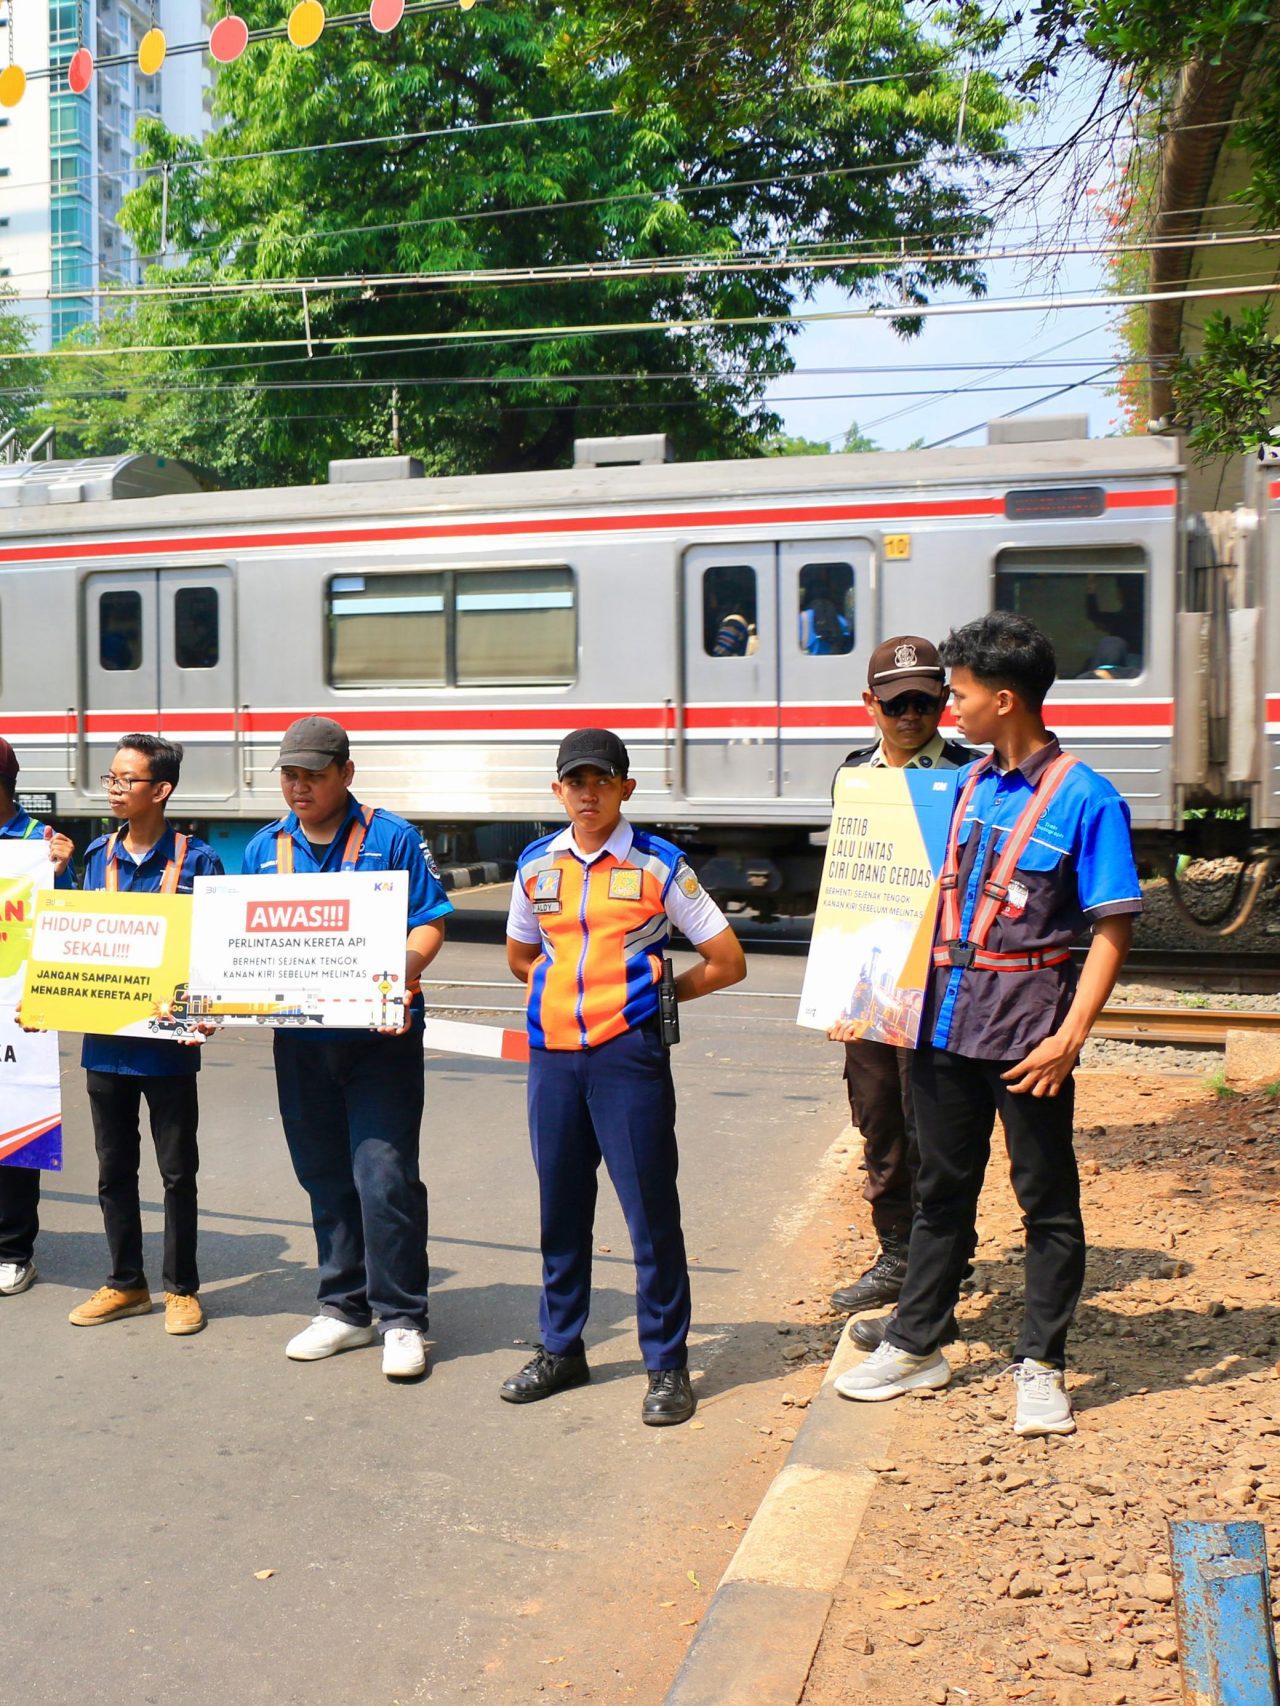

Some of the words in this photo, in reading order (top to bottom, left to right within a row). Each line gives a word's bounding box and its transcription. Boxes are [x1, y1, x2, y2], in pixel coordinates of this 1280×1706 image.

[885, 538, 908, 555] 10
[835, 817, 868, 836] TERTIB
[832, 839, 858, 857] LALU
[858, 841, 893, 861] LINTAS
[828, 861, 850, 879] CIRI
[851, 863, 886, 883] ORANG
[889, 866, 932, 888] CERDAS
[825, 886, 853, 897] BERHENTI
[854, 889, 881, 900] SEJENAK
[883, 893, 911, 904] TENGOK
[250, 905, 344, 928] AWAS!!!
[537, 904, 552, 912] ALDY
[823, 900, 845, 910] KANAN
[845, 902, 857, 911] KIRI
[858, 903, 889, 915] SEBELUM
[889, 907, 924, 919] MELINTAS
[41, 916, 92, 933] HIDUP
[96, 918, 160, 936] CUMAN
[62, 940, 130, 958] SEKALI!!!
[228, 938, 301, 948] PERLINTASAN
[304, 938, 345, 948] KERETA
[348, 937, 366, 947] API
[232, 957, 276, 966] BERHENTI
[278, 957, 317, 965] SEJENAK
[319, 956, 358, 965] TENGOK
[37, 970, 80, 981] JANGAN
[81, 972, 122, 984] SAMPAI
[123, 975, 150, 986] MATI
[223, 970, 255, 978] KANAN
[257, 970, 275, 978] KIRI
[278, 970, 319, 978] SEBELUM
[322, 969, 367, 978] MELINTAS
[31, 985, 89, 998] MENABRAK
[90, 989, 131, 1001] KERETA
[133, 992, 152, 1002] API
